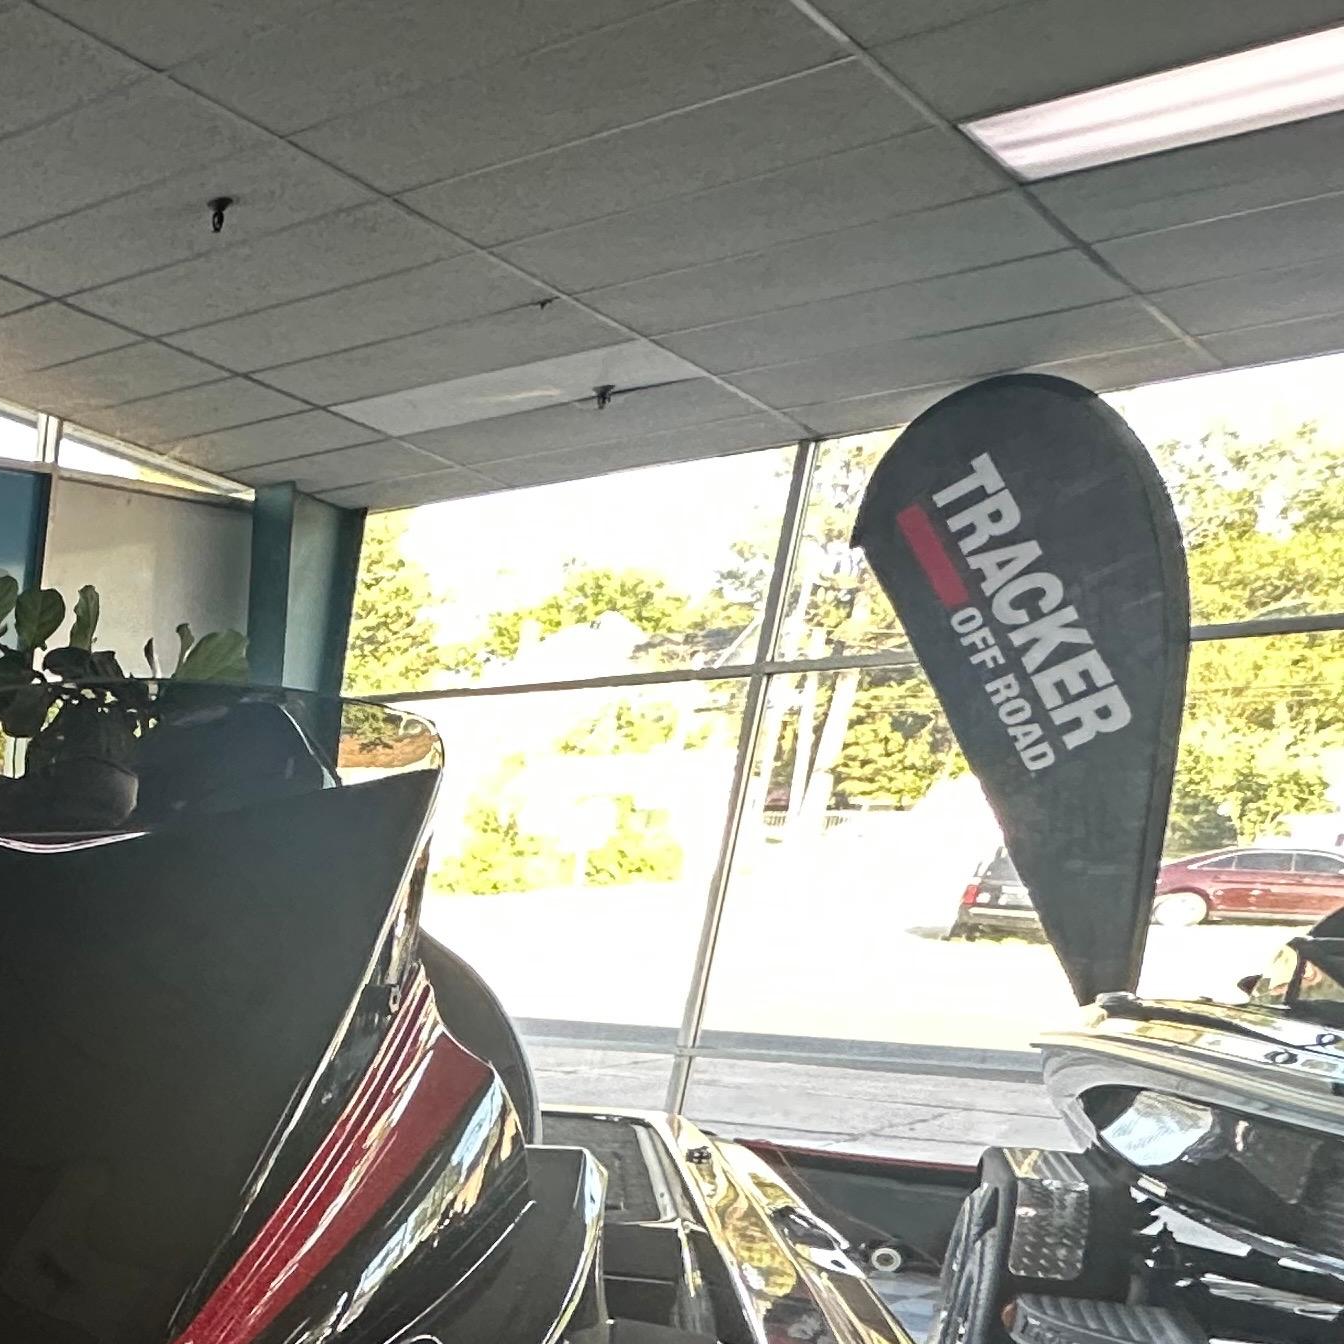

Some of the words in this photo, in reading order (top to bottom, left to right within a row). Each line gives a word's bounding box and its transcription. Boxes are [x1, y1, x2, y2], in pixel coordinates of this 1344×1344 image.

[932, 452, 1132, 750] TRACKER
[950, 606, 1006, 669] OFF
[984, 673, 1055, 771] ROAD
